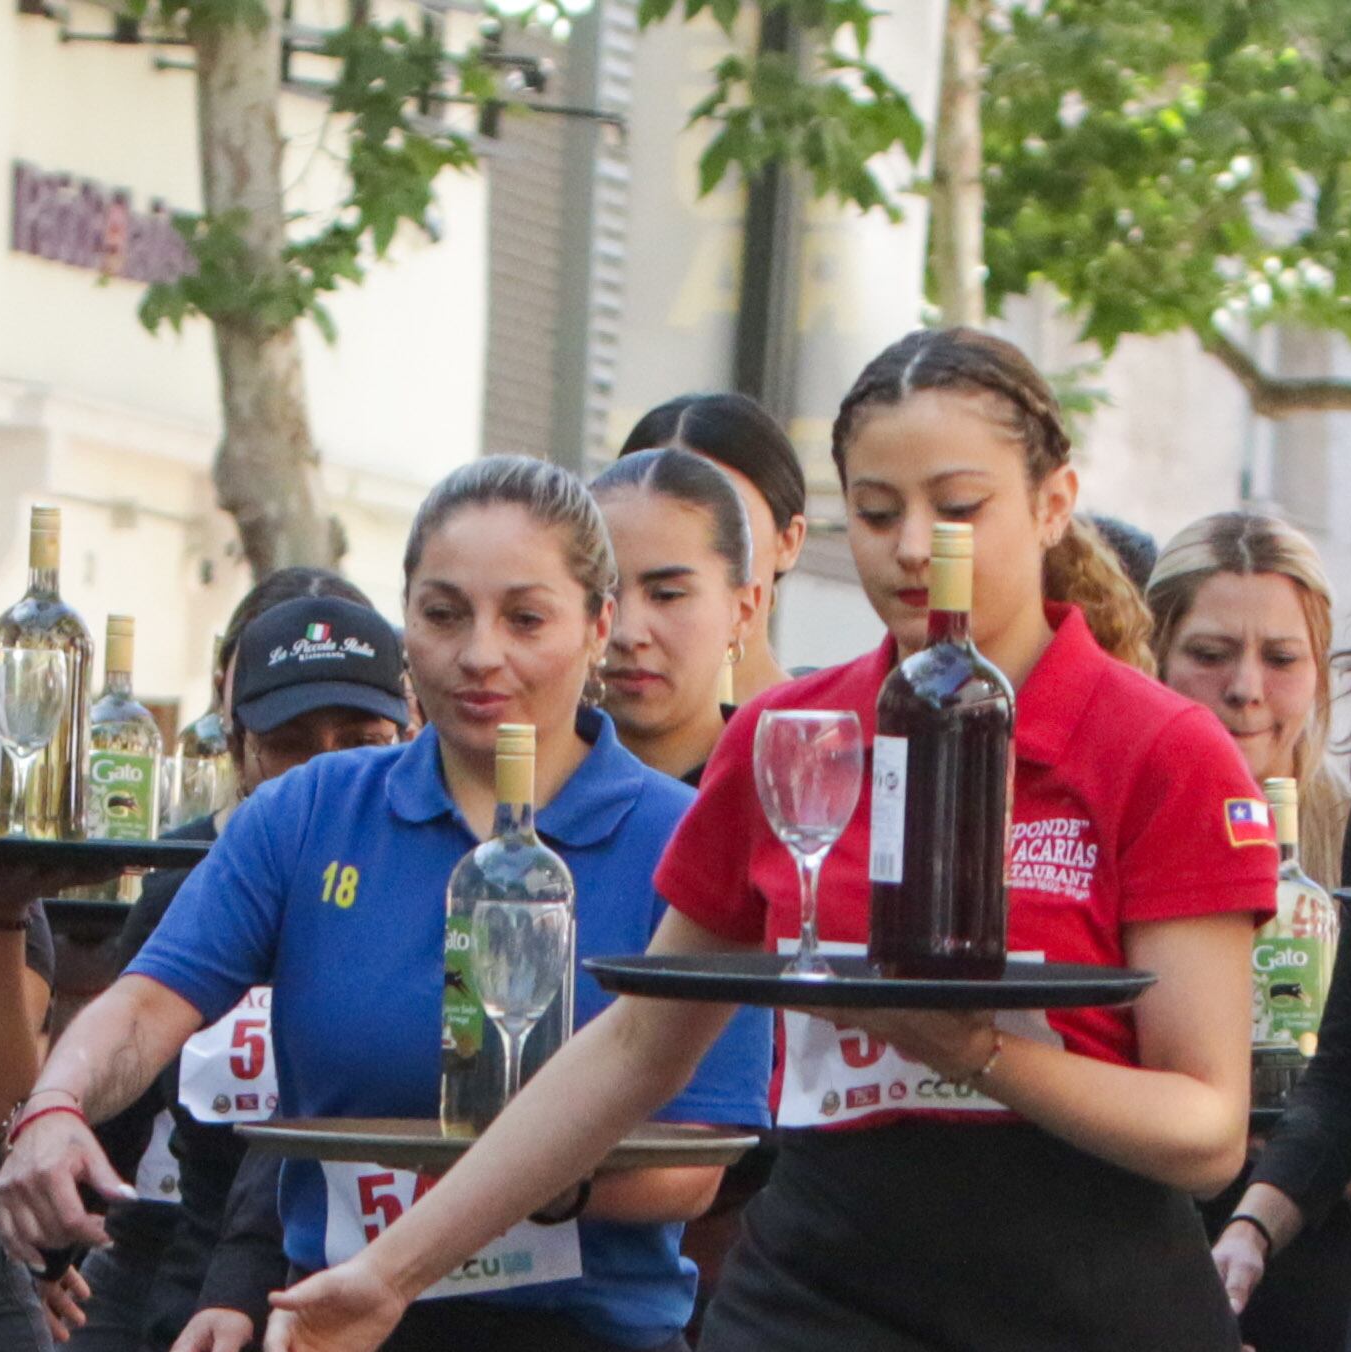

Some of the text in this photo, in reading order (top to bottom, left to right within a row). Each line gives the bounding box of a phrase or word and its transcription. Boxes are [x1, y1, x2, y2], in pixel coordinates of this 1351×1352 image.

[92, 759, 143, 784] Gato
[1011, 838, 1098, 869] ACARIAS
[322, 860, 359, 909] 18
[1011, 863, 1093, 888] TAURANT
[1252, 945, 1309, 972] Gato
